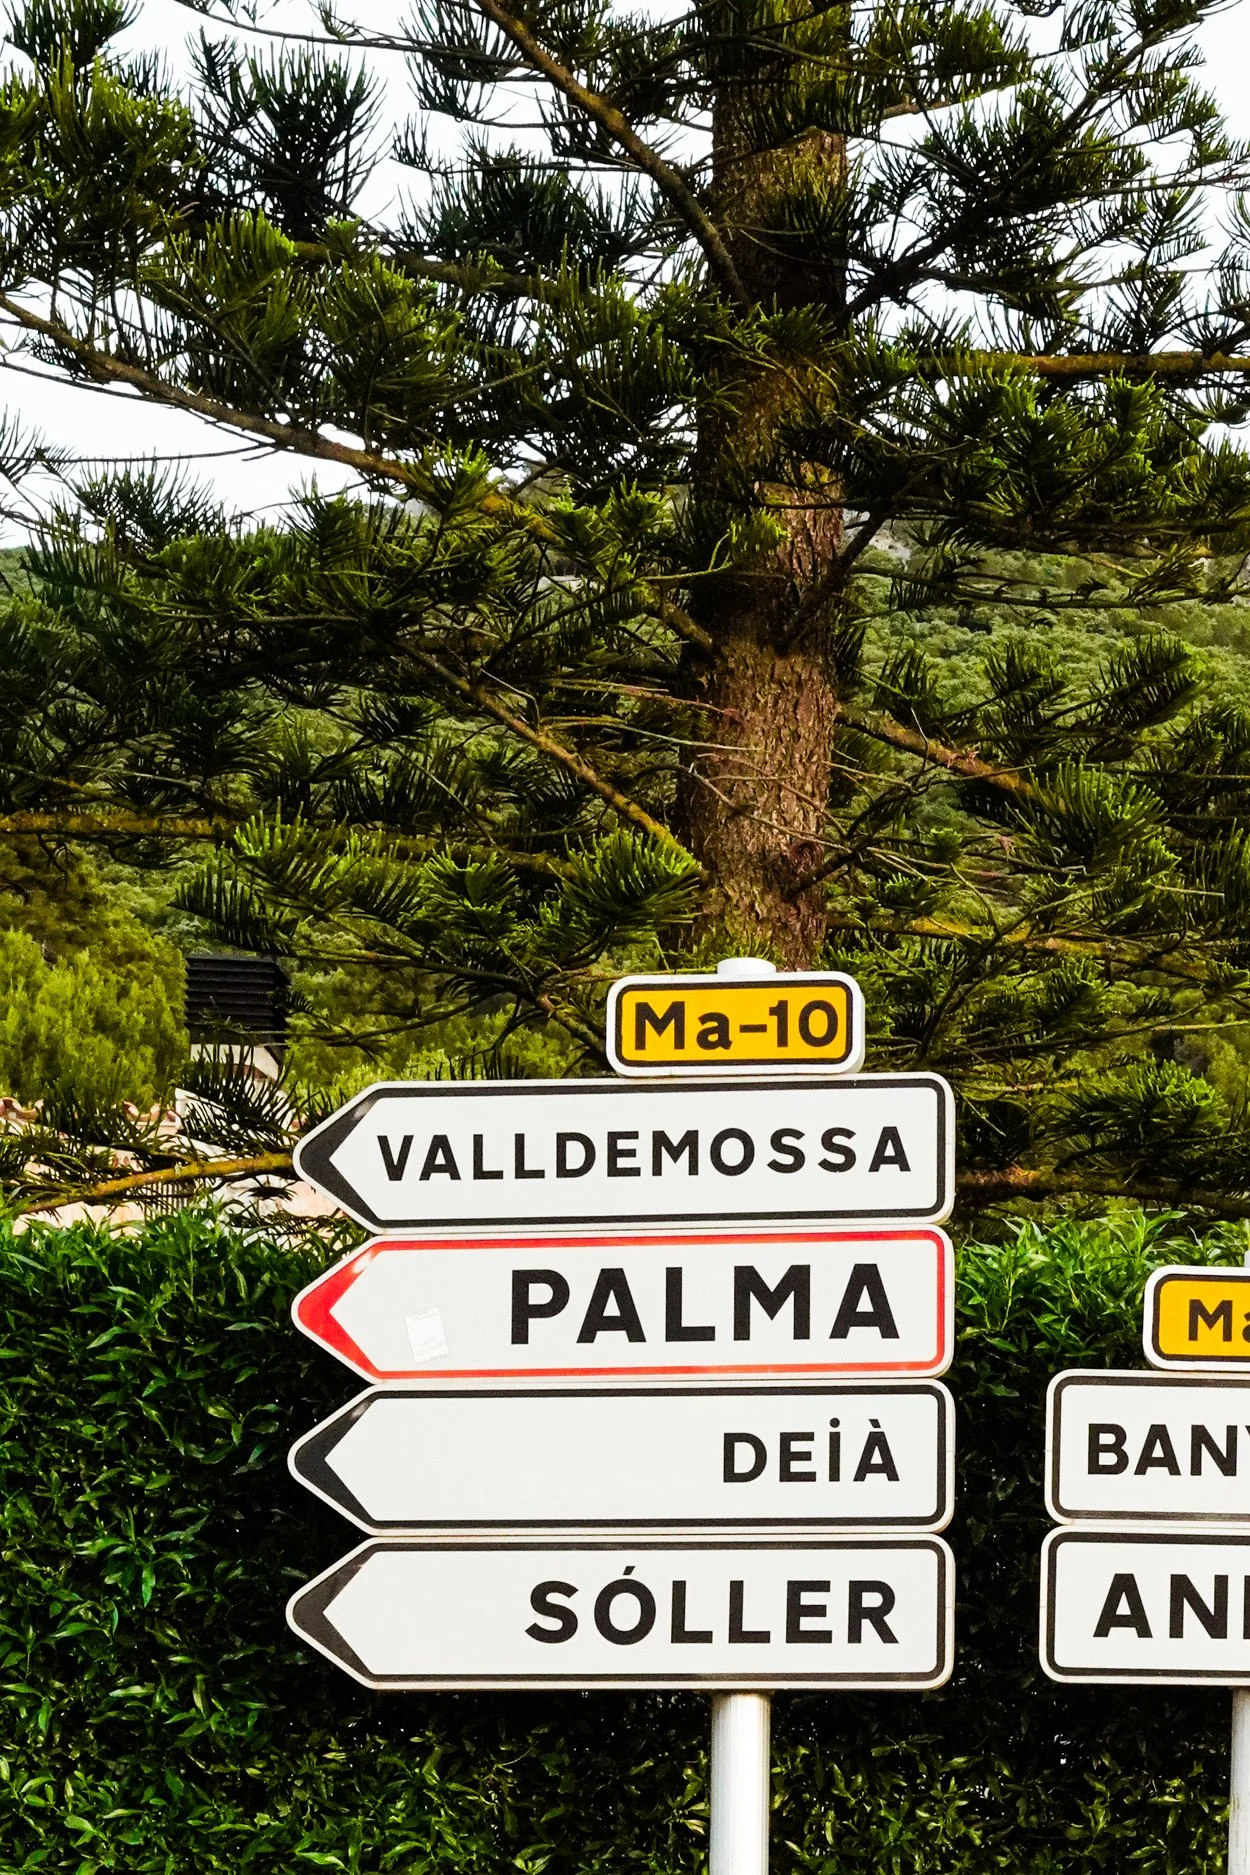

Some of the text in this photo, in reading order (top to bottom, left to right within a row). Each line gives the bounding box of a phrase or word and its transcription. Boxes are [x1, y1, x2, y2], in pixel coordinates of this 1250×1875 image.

[632, 999, 840, 1052] Ma-10
[376, 1126, 912, 1182] VALLDEMOSSA
[510, 1263, 900, 1345] PALMA
[524, 1565, 899, 1646] SÓLLER
